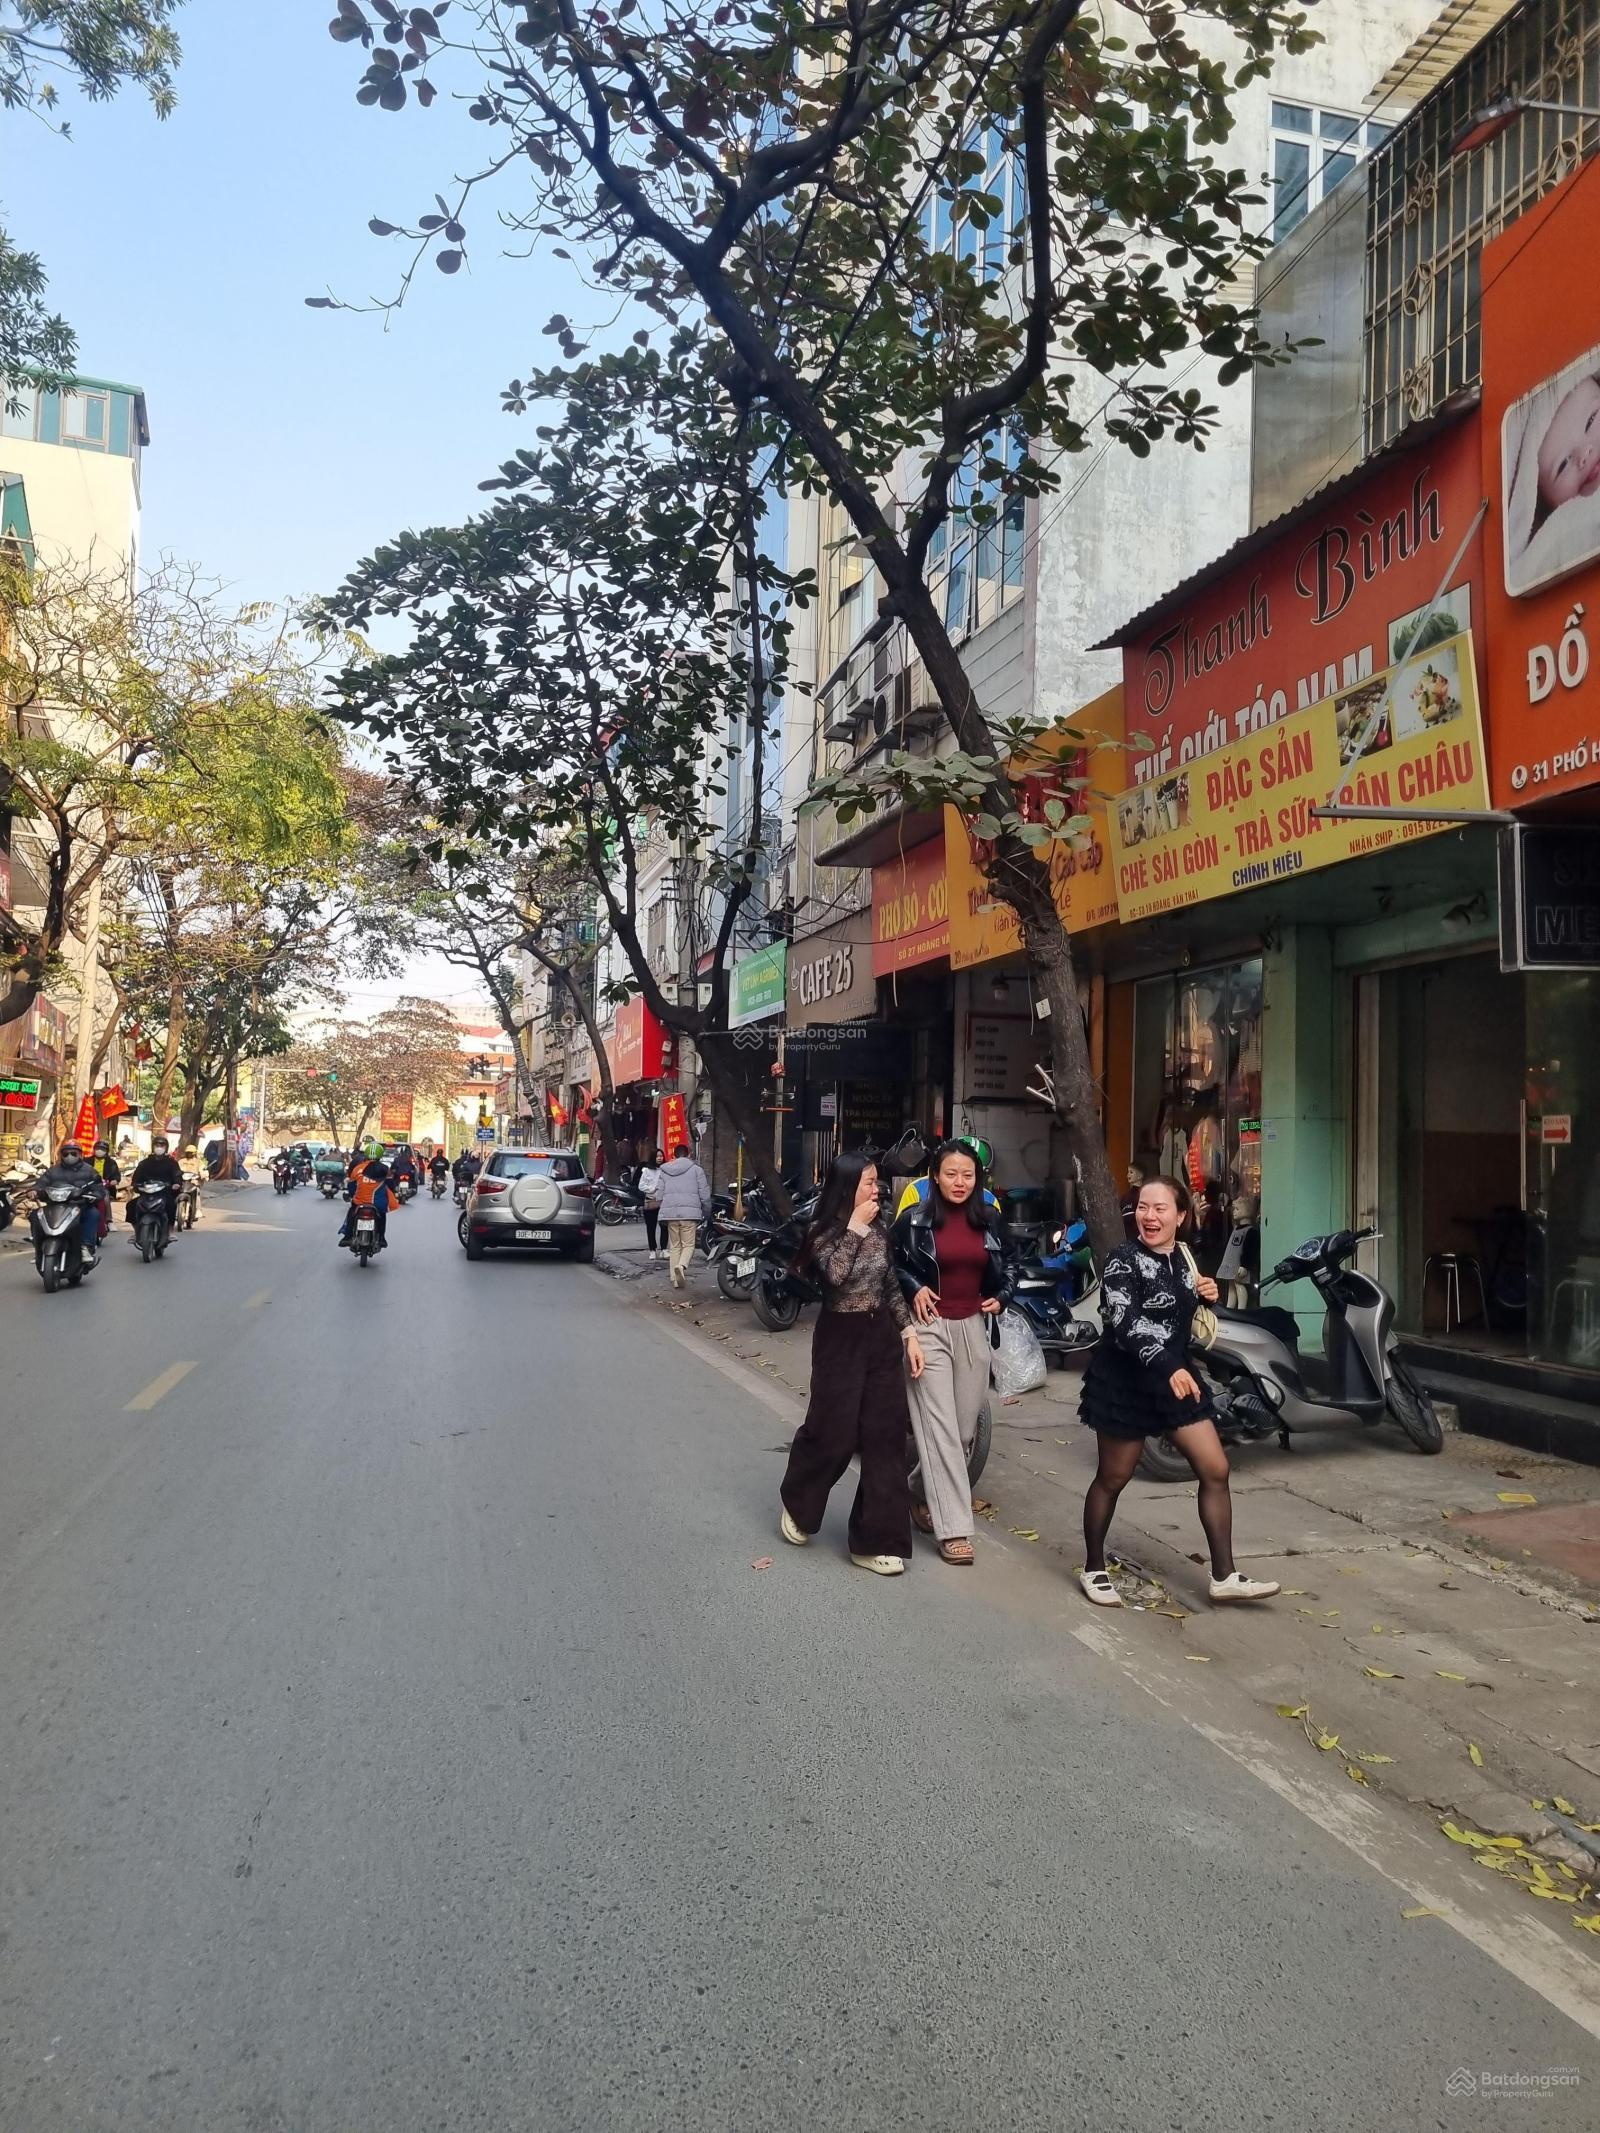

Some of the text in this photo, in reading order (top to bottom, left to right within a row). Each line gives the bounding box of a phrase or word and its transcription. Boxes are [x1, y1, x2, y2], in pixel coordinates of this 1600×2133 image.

[1143, 466, 1444, 716] Thanh Bình
[1526, 601, 1589, 704] ĐỒ
[1206, 726, 1314, 813] ĐẶC SẢN
[1533, 760, 1549, 784] 31
[1553, 736, 1589, 776] PHỐ
[1120, 853, 1149, 895] CHÈ
[1151, 845, 1180, 885] SÀI
[1182, 831, 1220, 876] GÒN
[1234, 809, 1273, 858] TRÀ
[1277, 795, 1323, 844] SỮA
[1398, 740, 1475, 804] CHÂU
[1349, 834, 1374, 856] NHẬN
[1375, 828, 1394, 847] SHIP
[1232, 850, 1304, 888] CHÍNH HIỆU
[903, 881, 919, 932] BÒ
[800, 954, 833, 1007] CAFE
[834, 944, 855, 995] 25
